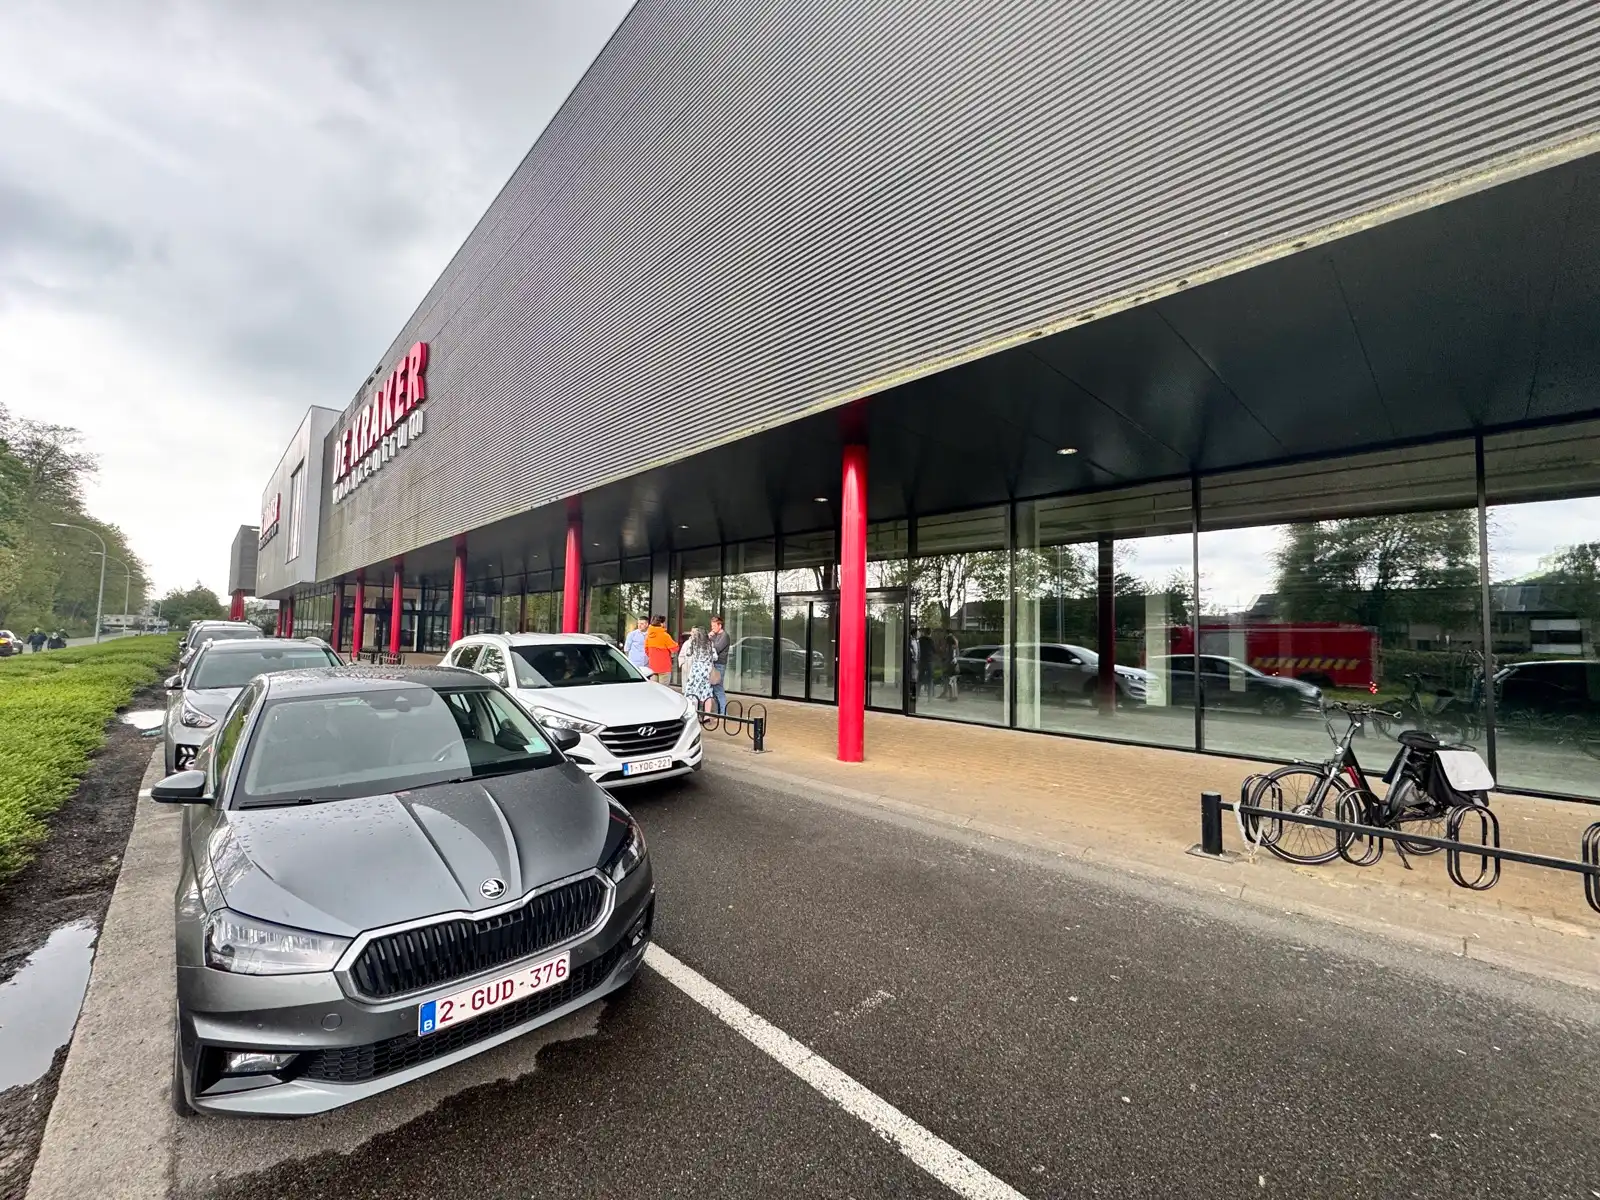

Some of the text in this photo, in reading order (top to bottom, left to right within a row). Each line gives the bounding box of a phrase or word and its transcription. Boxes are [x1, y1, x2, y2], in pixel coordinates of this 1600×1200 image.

[332, 341, 427, 484] DE KRAKER
[439, 958, 567, 1024] 2-GUD-376
[423, 1019, 434, 1032] B
